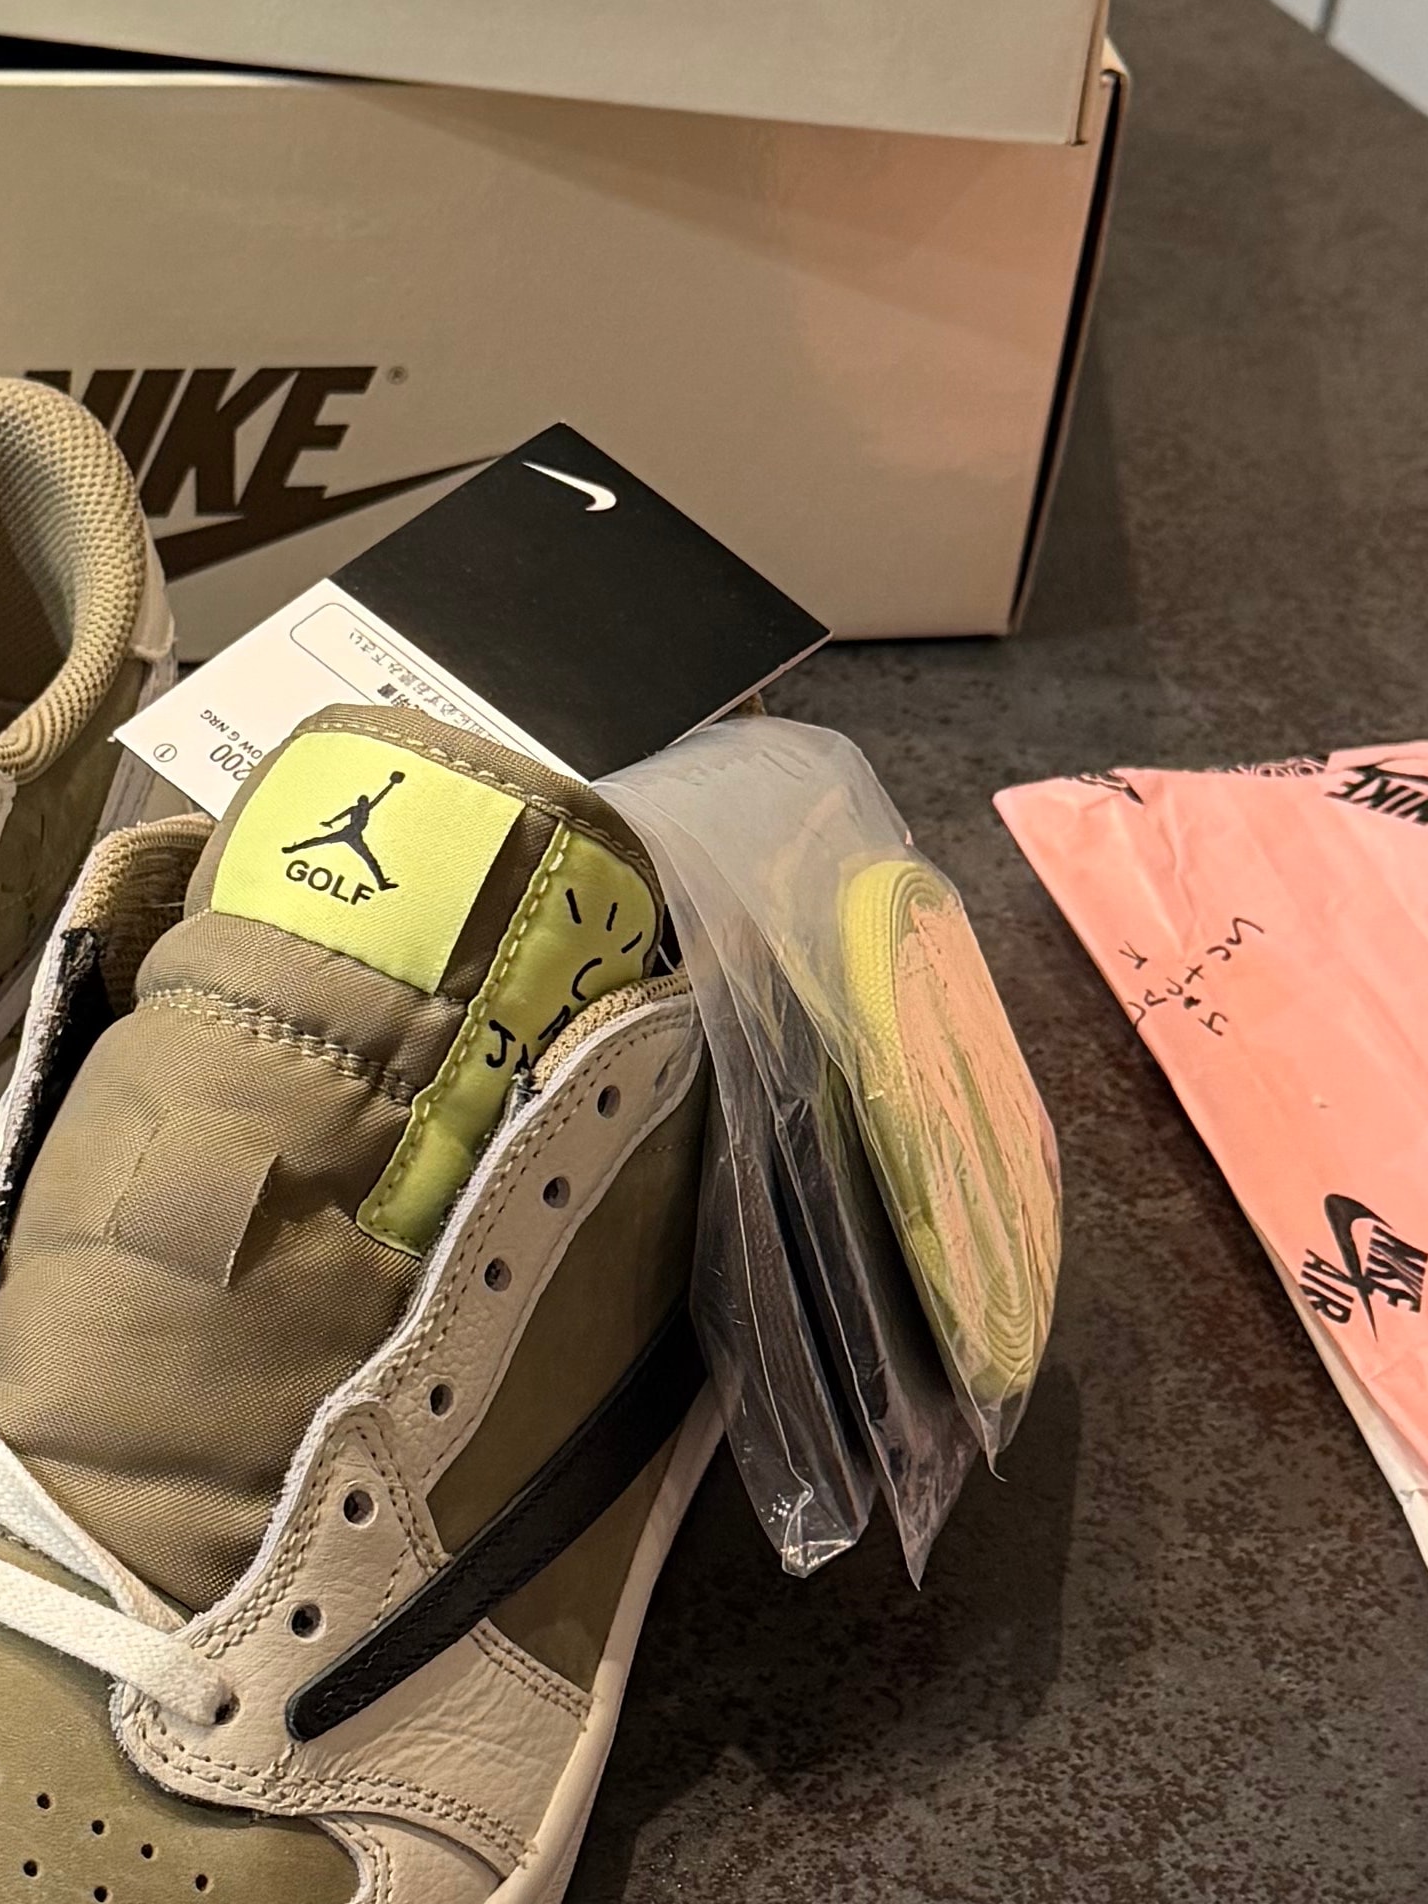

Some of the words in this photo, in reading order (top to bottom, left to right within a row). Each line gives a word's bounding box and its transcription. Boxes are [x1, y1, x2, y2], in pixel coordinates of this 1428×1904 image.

[200, 709, 230, 733] NRG
[227, 730, 240, 742] G
[238, 740, 263, 760] OW
[285, 859, 375, 905] GOLF
[1298, 1248, 1356, 1325] AIR
